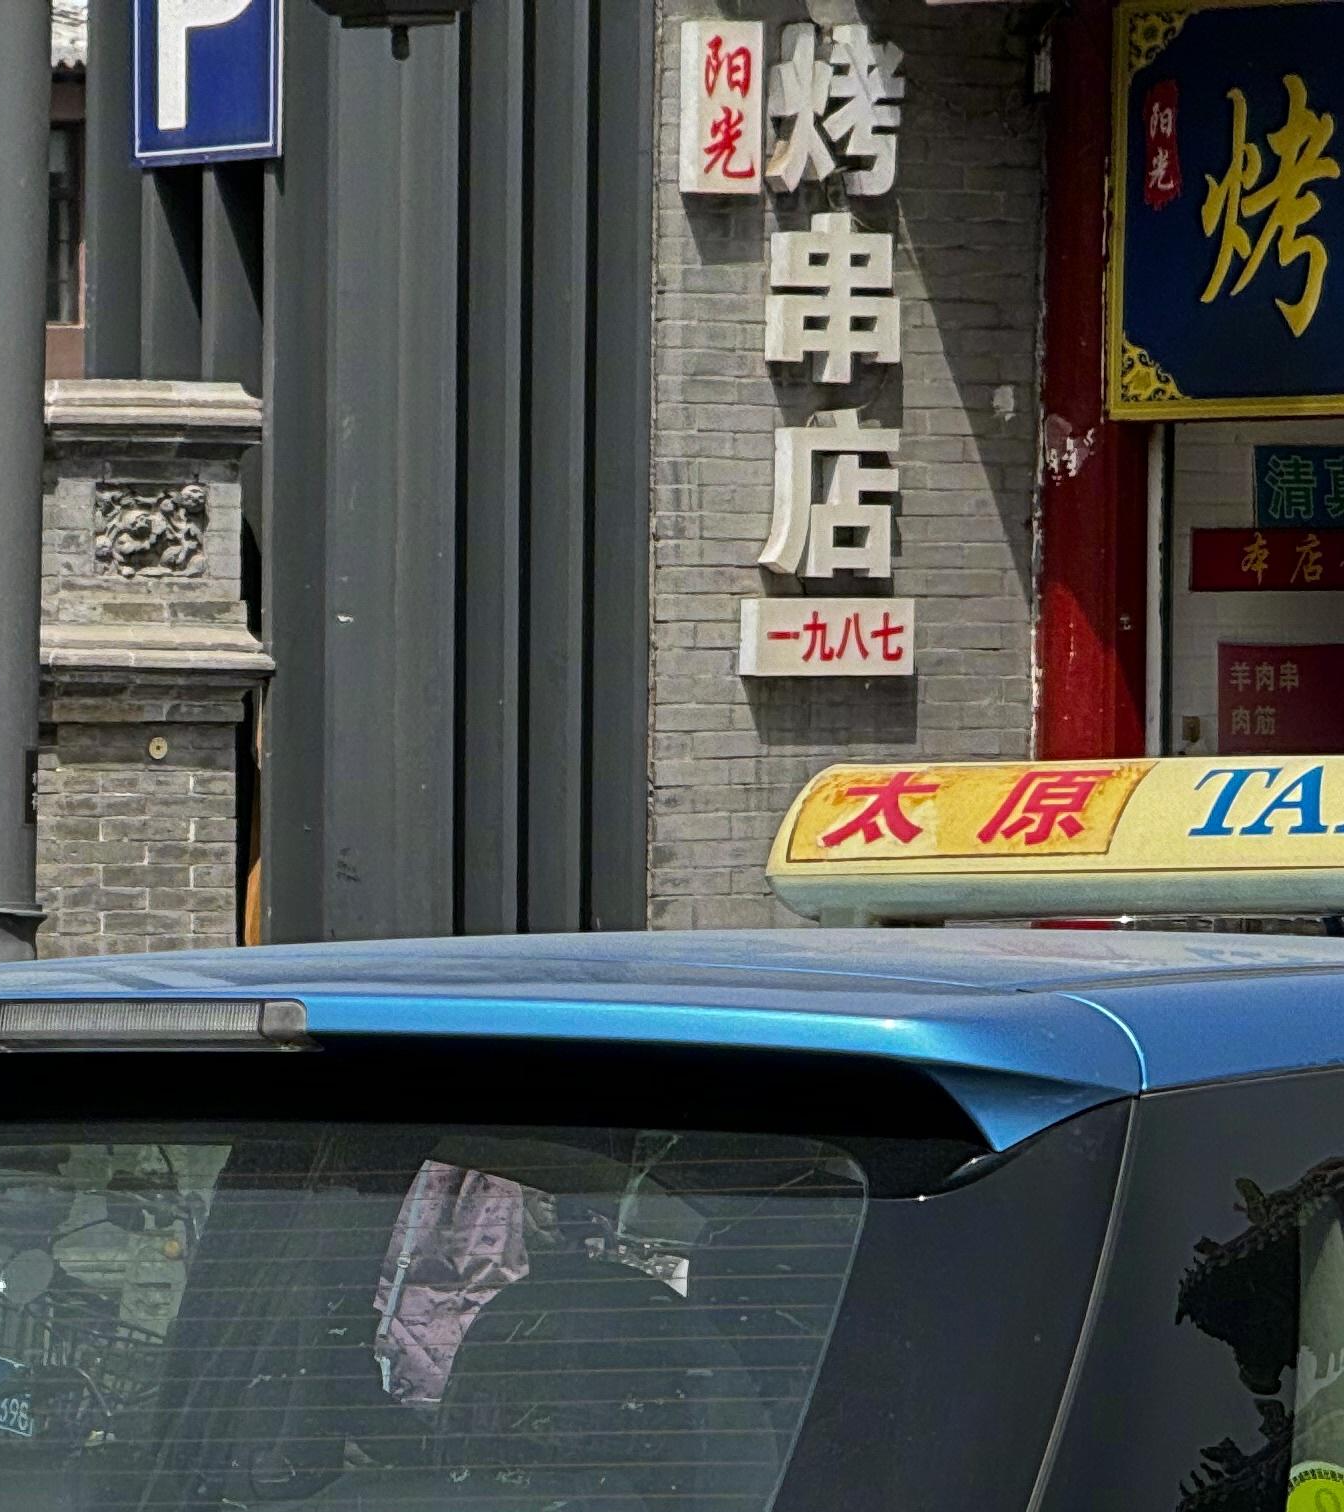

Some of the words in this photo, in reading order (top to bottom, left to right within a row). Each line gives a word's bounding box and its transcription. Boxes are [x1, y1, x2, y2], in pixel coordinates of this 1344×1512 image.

[703, 36, 756, 179] 阳光
[1148, 101, 1175, 191] 阳光
[1200, 73, 1341, 338] 烤
[758, 23, 905, 579] 烤串店
[766, 610, 905, 663] 一九八七
[1229, 661, 1300, 692] 羊肉串
[1231, 705, 1277, 737] 肉筋
[817, 770, 1116, 847] 太原
[1188, 765, 1344, 837] TA
